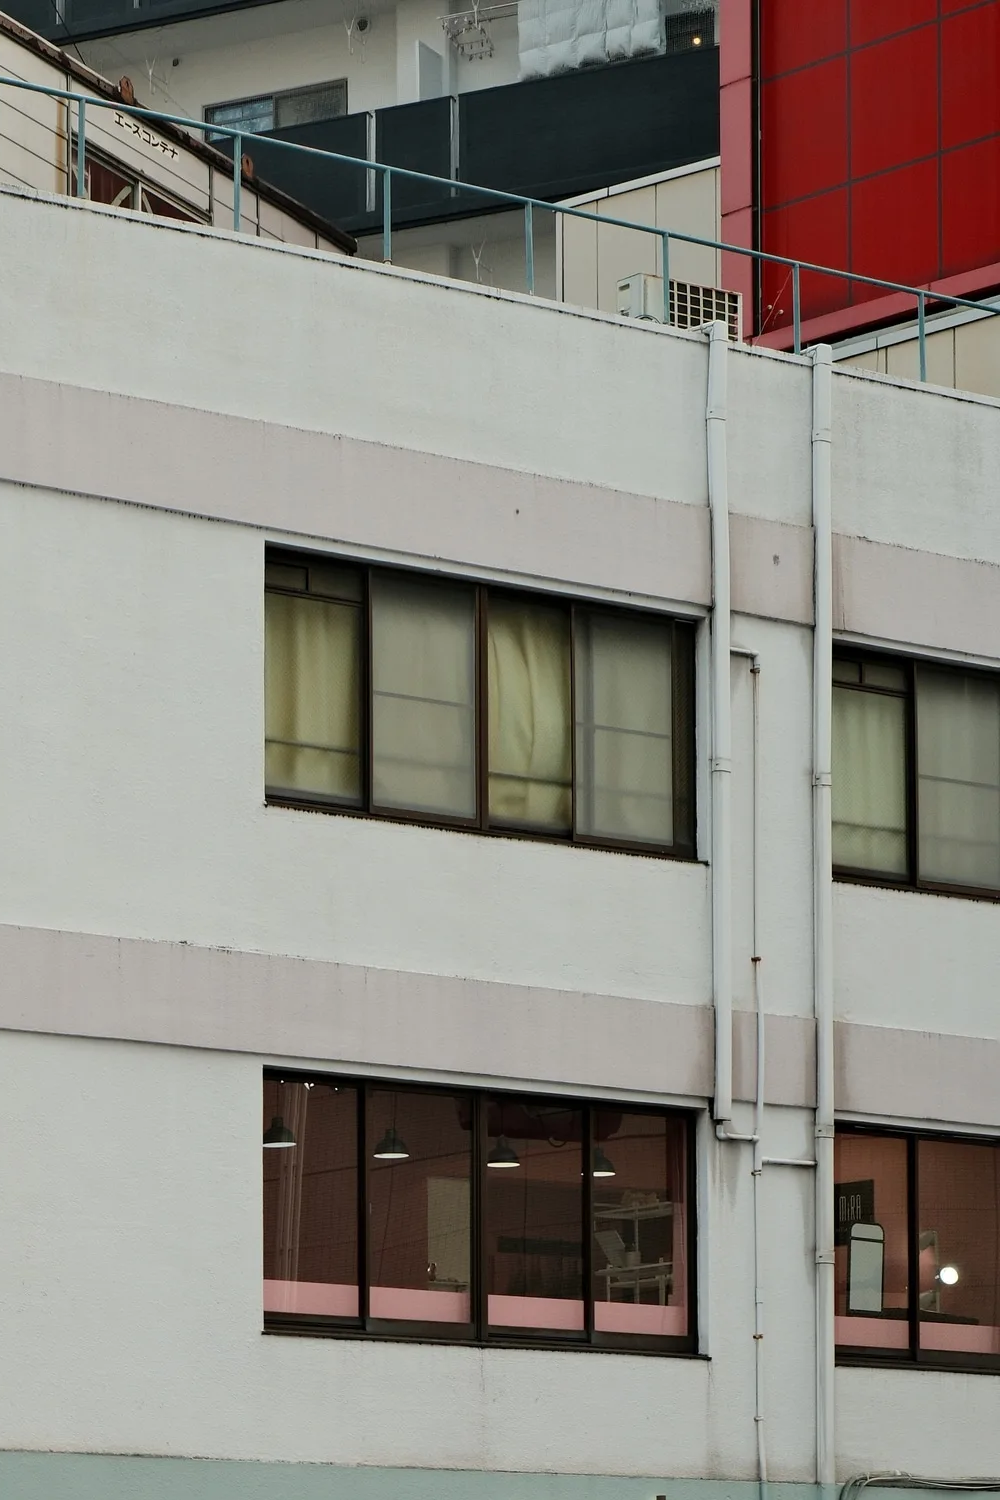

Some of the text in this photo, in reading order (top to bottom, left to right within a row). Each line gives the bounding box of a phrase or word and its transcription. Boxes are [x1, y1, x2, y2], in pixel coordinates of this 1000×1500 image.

[115, 112, 178, 158] エースコンテナ
